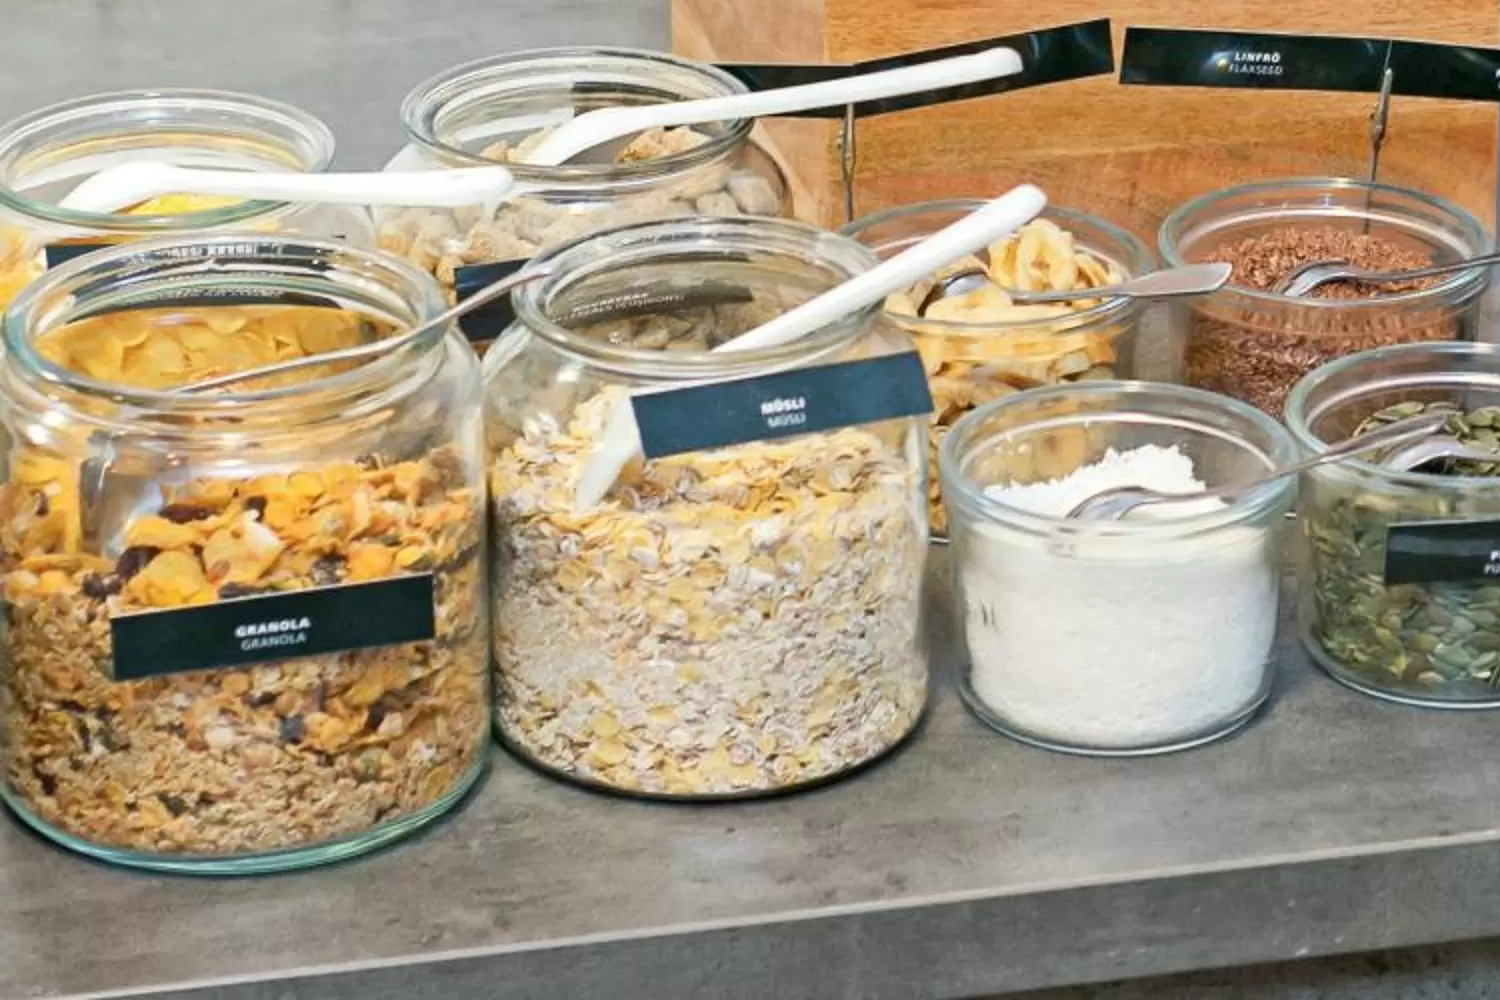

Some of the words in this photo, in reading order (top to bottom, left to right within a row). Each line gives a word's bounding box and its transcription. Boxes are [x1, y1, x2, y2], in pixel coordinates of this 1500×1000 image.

[1228, 63, 1284, 75] FLAXSEED
[234, 616, 312, 638] GRANOLA
[240, 631, 307, 652] GRANOLA
